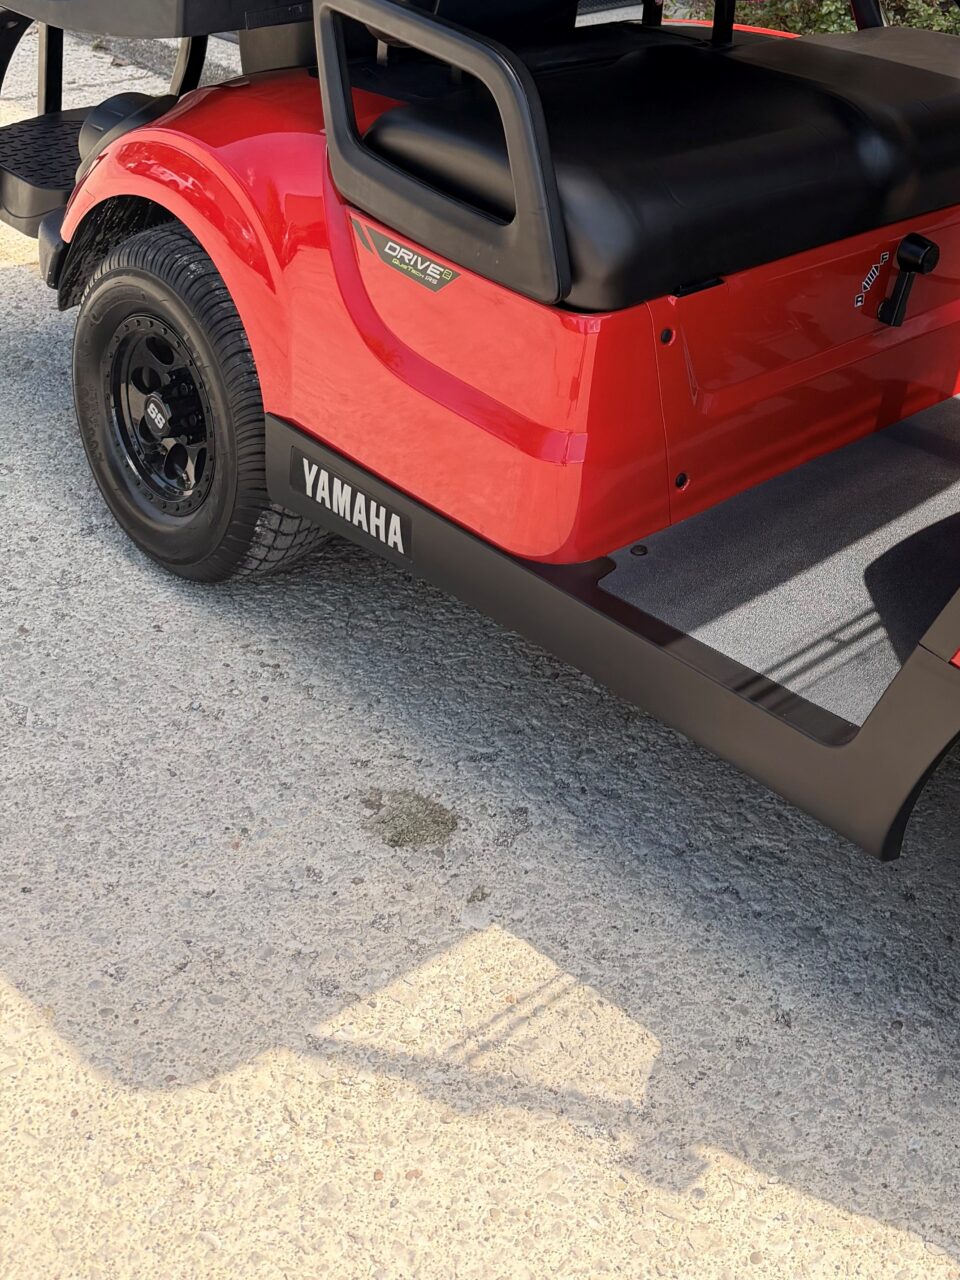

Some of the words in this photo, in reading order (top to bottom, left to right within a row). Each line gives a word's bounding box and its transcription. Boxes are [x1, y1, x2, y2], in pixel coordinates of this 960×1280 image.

[880, 251, 890, 266] F
[854, 293, 865, 308] R
[146, 402, 166, 429] SS
[302, 458, 404, 554] YAMAHA
